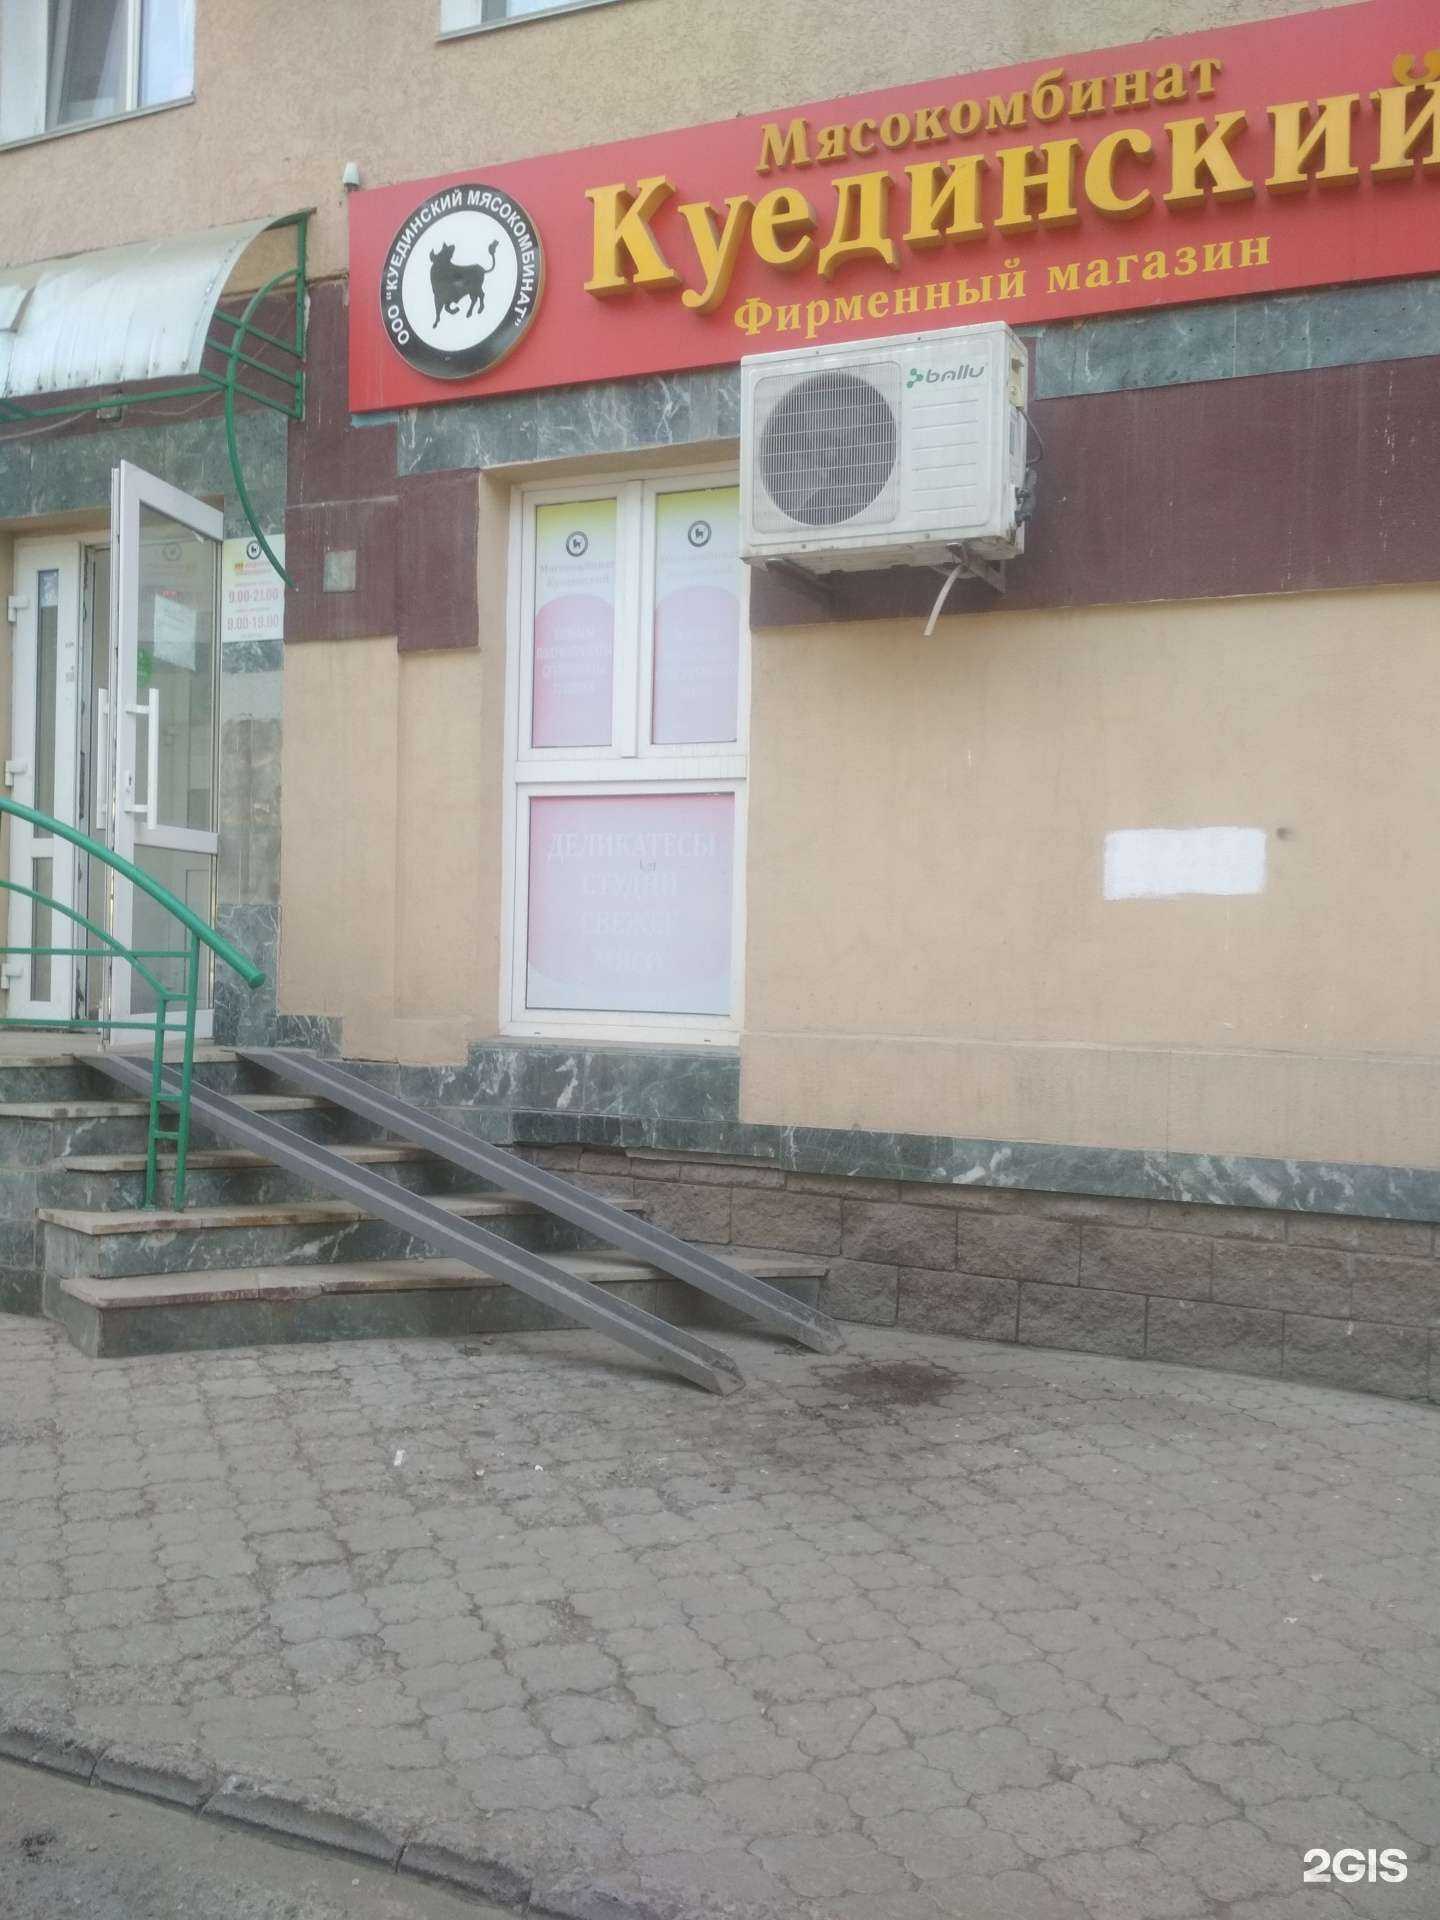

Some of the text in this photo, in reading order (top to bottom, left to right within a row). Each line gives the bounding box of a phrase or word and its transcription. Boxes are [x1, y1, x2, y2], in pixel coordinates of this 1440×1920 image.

[757, 58, 1223, 173] Мясокомбинат
[584, 49, 1440, 314] Куединский
[387, 305, 410, 345] ООО
[734, 236, 1272, 339] Фирменный магазин
[546, 832, 718, 864] ДЕЛИКАТЕСЫ
